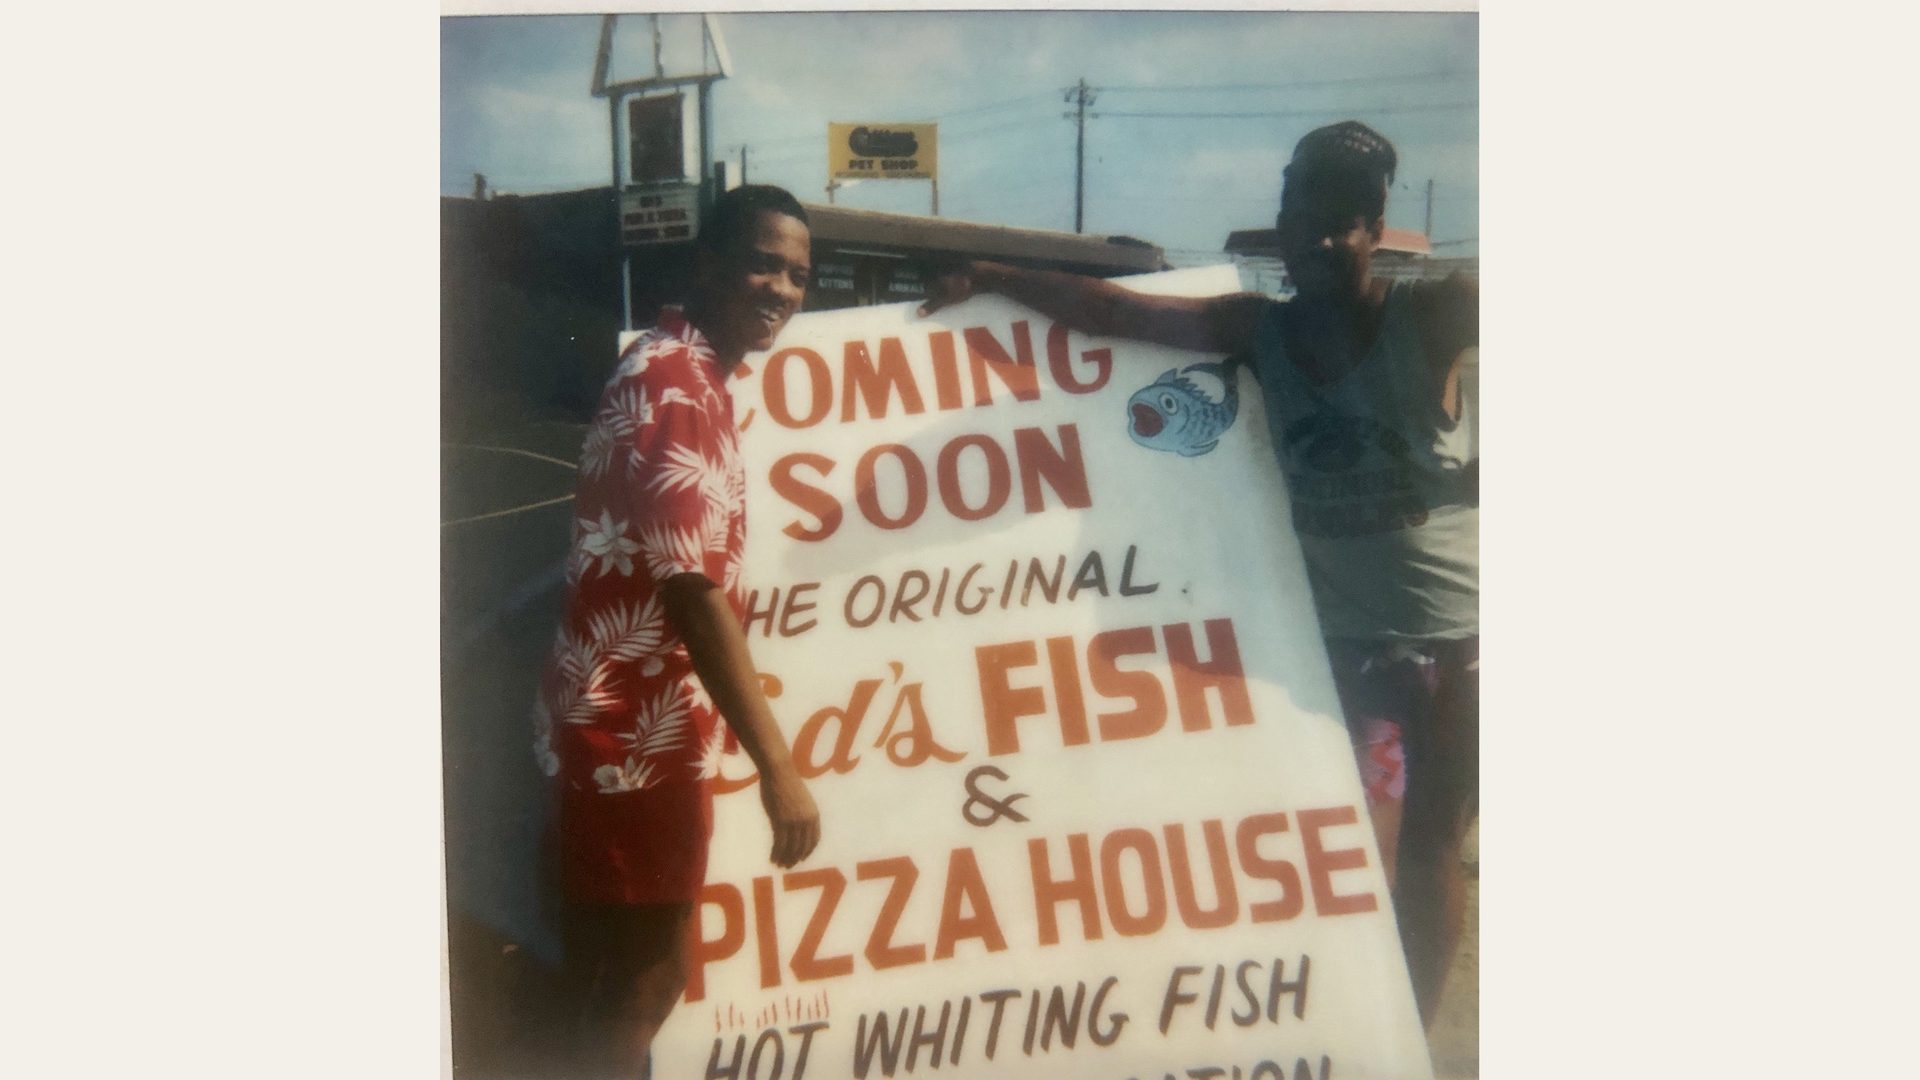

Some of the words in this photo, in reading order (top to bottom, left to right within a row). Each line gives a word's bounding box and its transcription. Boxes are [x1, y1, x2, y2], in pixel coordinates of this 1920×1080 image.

[848, 159, 874, 170] PET
[768, 423, 1093, 543] SOON
[742, 582, 822, 638] HE
[843, 544, 1160, 628] ORIGINAL
[710, 661, 969, 795] d's
[974, 617, 1256, 758] FISH
[962, 764, 1031, 828] &
[684, 847, 1008, 1005] PIZZA
[1027, 805, 1379, 947] HOUSE
[704, 1020, 830, 1080] HOT
[852, 976, 1131, 1080] WHITING
[1158, 954, 1312, 1035] FISH
